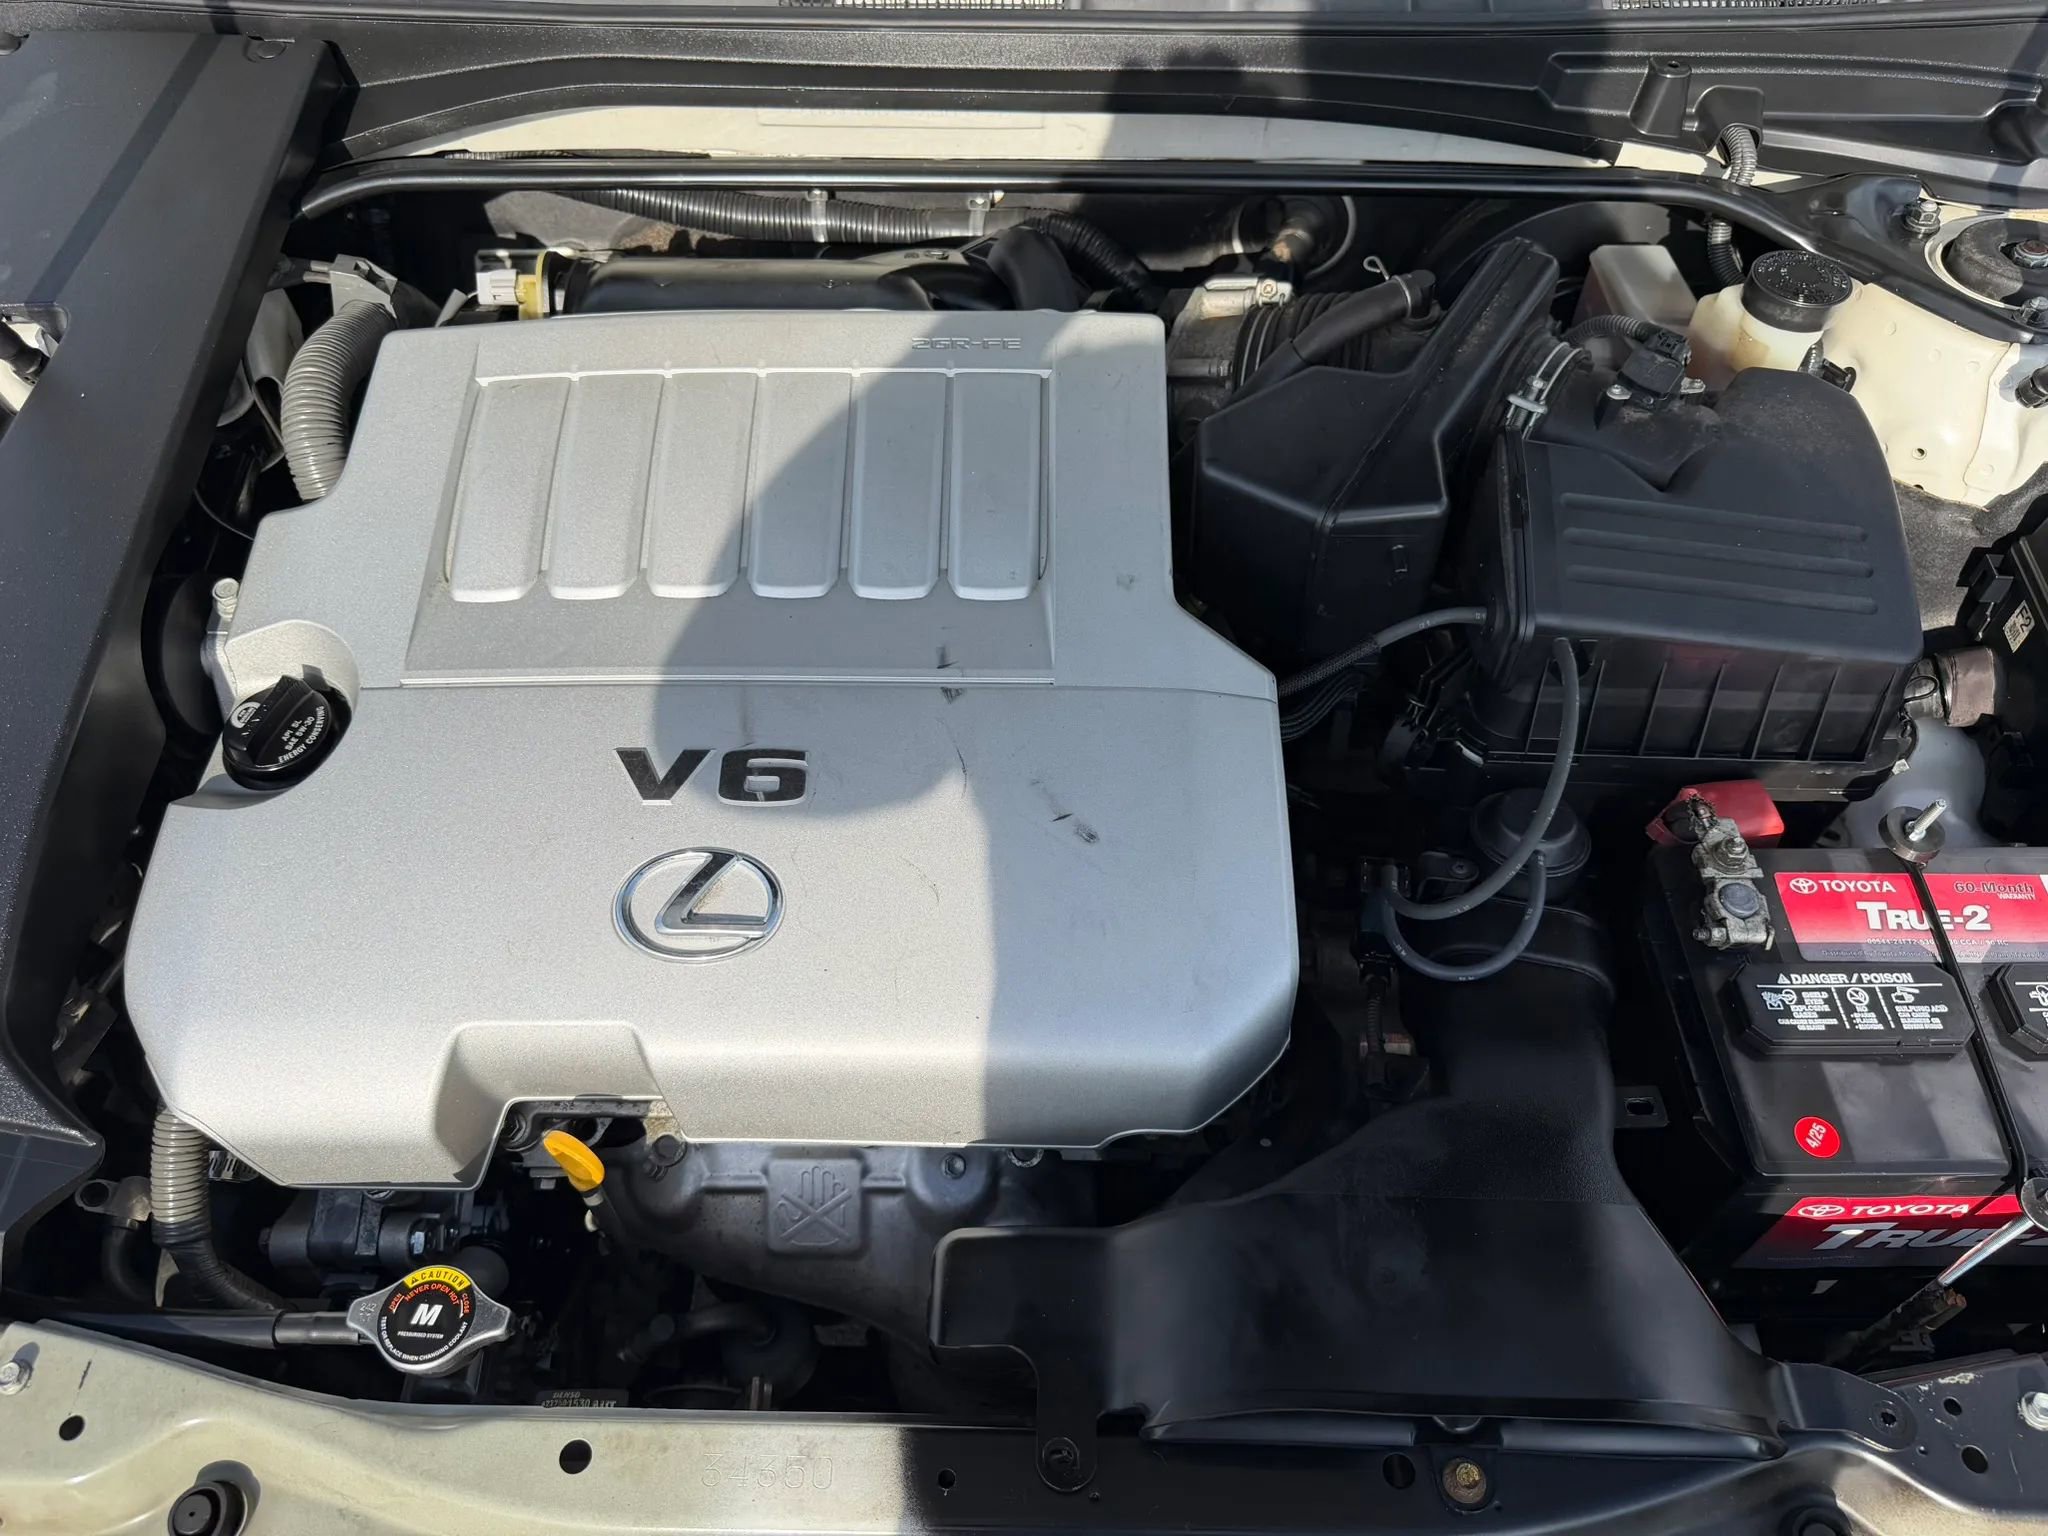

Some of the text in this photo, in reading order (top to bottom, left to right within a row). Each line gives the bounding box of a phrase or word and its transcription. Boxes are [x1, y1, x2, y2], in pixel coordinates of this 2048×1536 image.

[912, 337, 1021, 350] 2GR-FE
[278, 705, 325, 763] ENERGY CONSERVING
[613, 747, 809, 806] V6
[1818, 879, 1897, 893] TOYOTA
[1954, 882, 2035, 894] 60-Month
[1790, 974, 1849, 984] DANGER
[1861, 973, 1915, 984] POISON
[1806, 1122, 1827, 1149] 4/25
[1851, 1203, 1970, 1216] TOYOTA
[420, 1270, 465, 1288] CAUTION
[389, 1292, 403, 1311] OPEN
[404, 1283, 460, 1305] NEVER OPEN HOT
[461, 1292, 470, 1314] CLOSE
[410, 1303, 443, 1326] M
[385, 1338, 403, 1358] REPLACE
[419, 1346, 449, 1361] CHANGING
[448, 1321, 468, 1347] COOLANT
[701, 1453, 833, 1490] 34350
